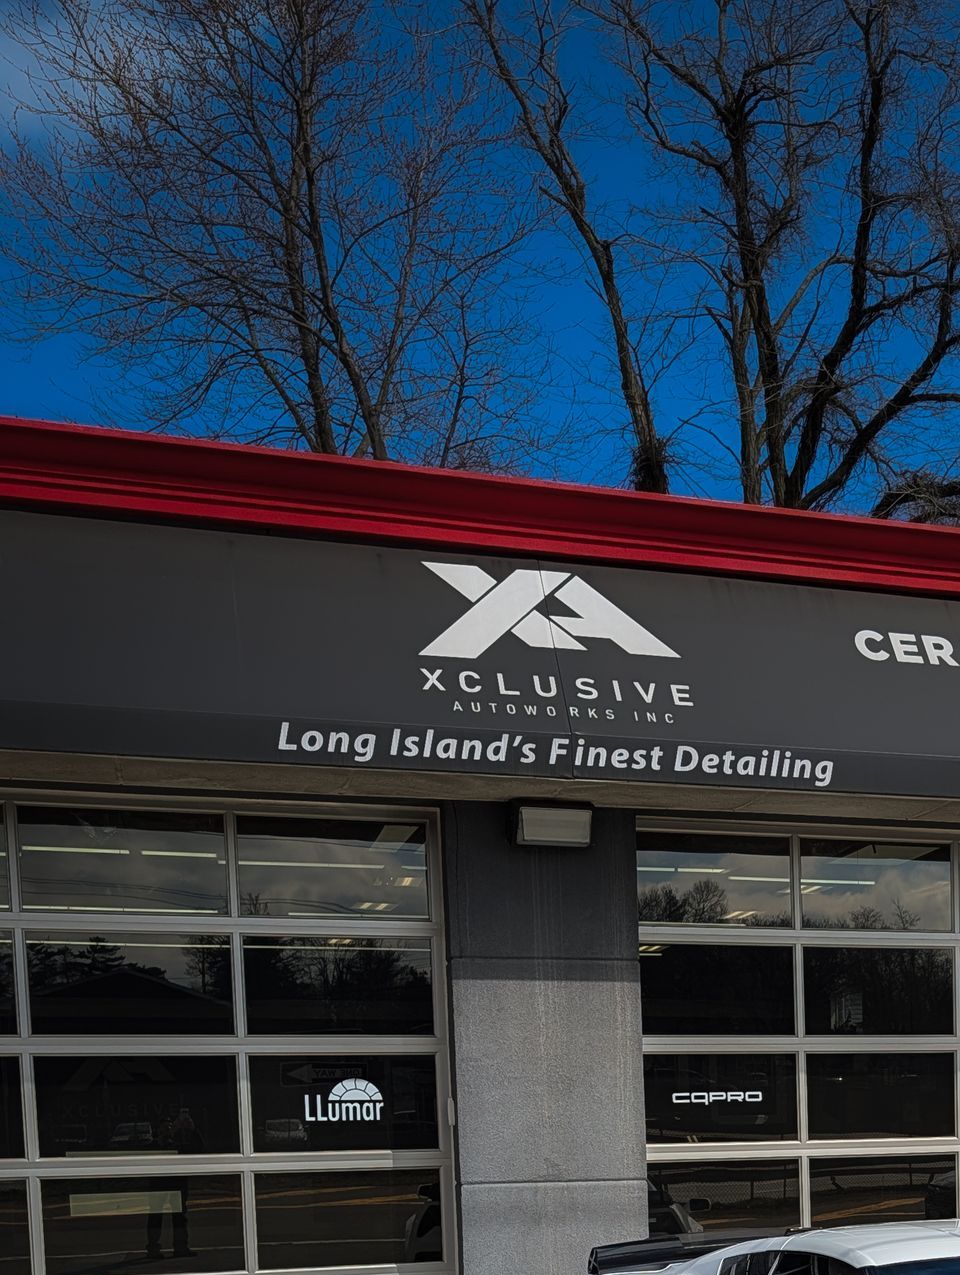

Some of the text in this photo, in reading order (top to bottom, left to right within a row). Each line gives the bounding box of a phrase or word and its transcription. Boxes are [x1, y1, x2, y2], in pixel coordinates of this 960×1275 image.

[419, 667, 694, 708] XCLUSIVE
[453, 701, 675, 724] AUTOWORKS INC
[278, 722, 376, 762] Long
[548, 737, 663, 771] Finest
[674, 745, 834, 786] Detailing
[304, 1094, 384, 1122] LLumar
